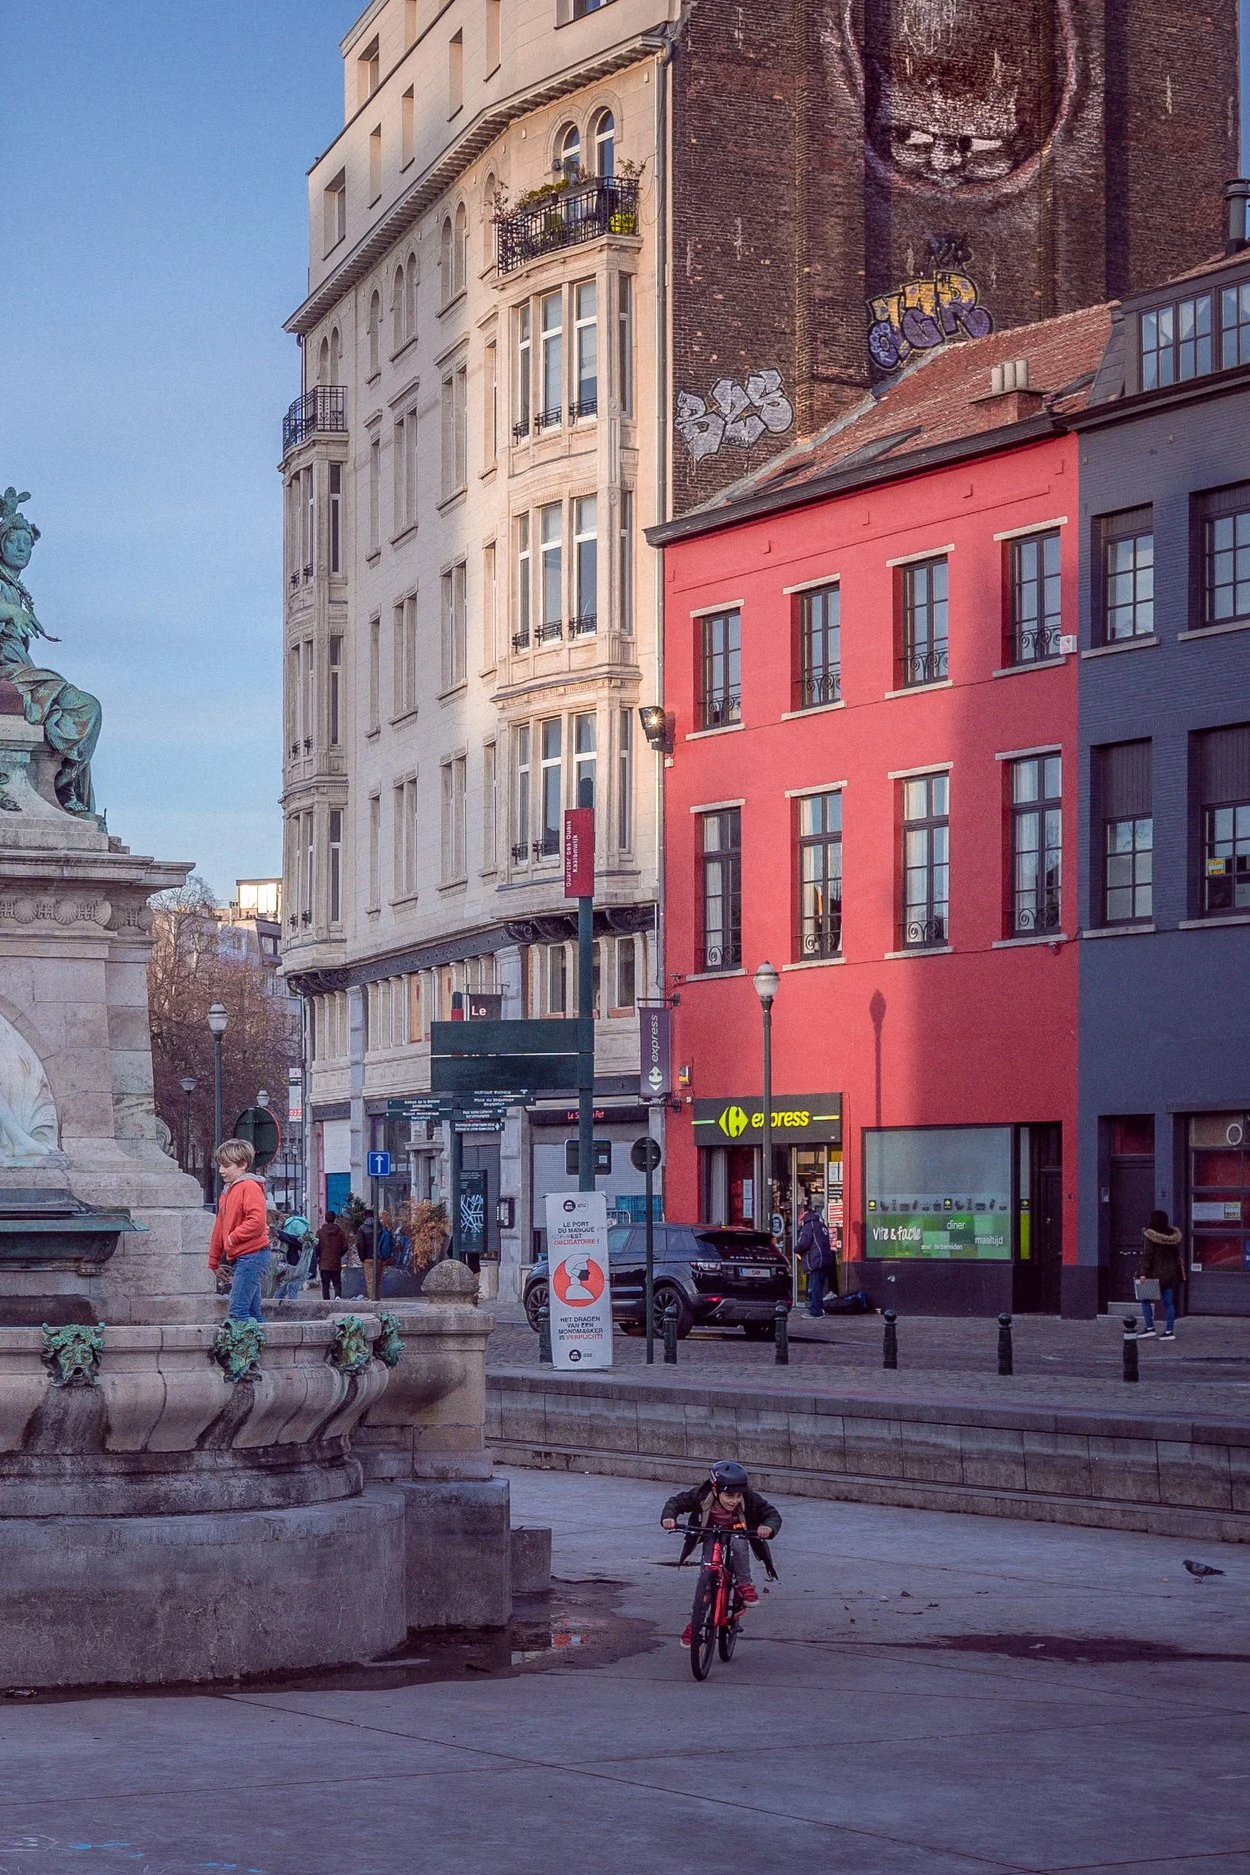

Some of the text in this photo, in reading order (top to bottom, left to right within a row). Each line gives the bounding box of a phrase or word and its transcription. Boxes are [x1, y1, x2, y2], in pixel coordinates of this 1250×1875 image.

[471, 1005, 487, 1016] Le
[651, 1014, 660, 1062] express
[872, 1227, 889, 1241] Vite
[897, 1226, 921, 1241] facile
[974, 1235, 1004, 1247] maaltijd
